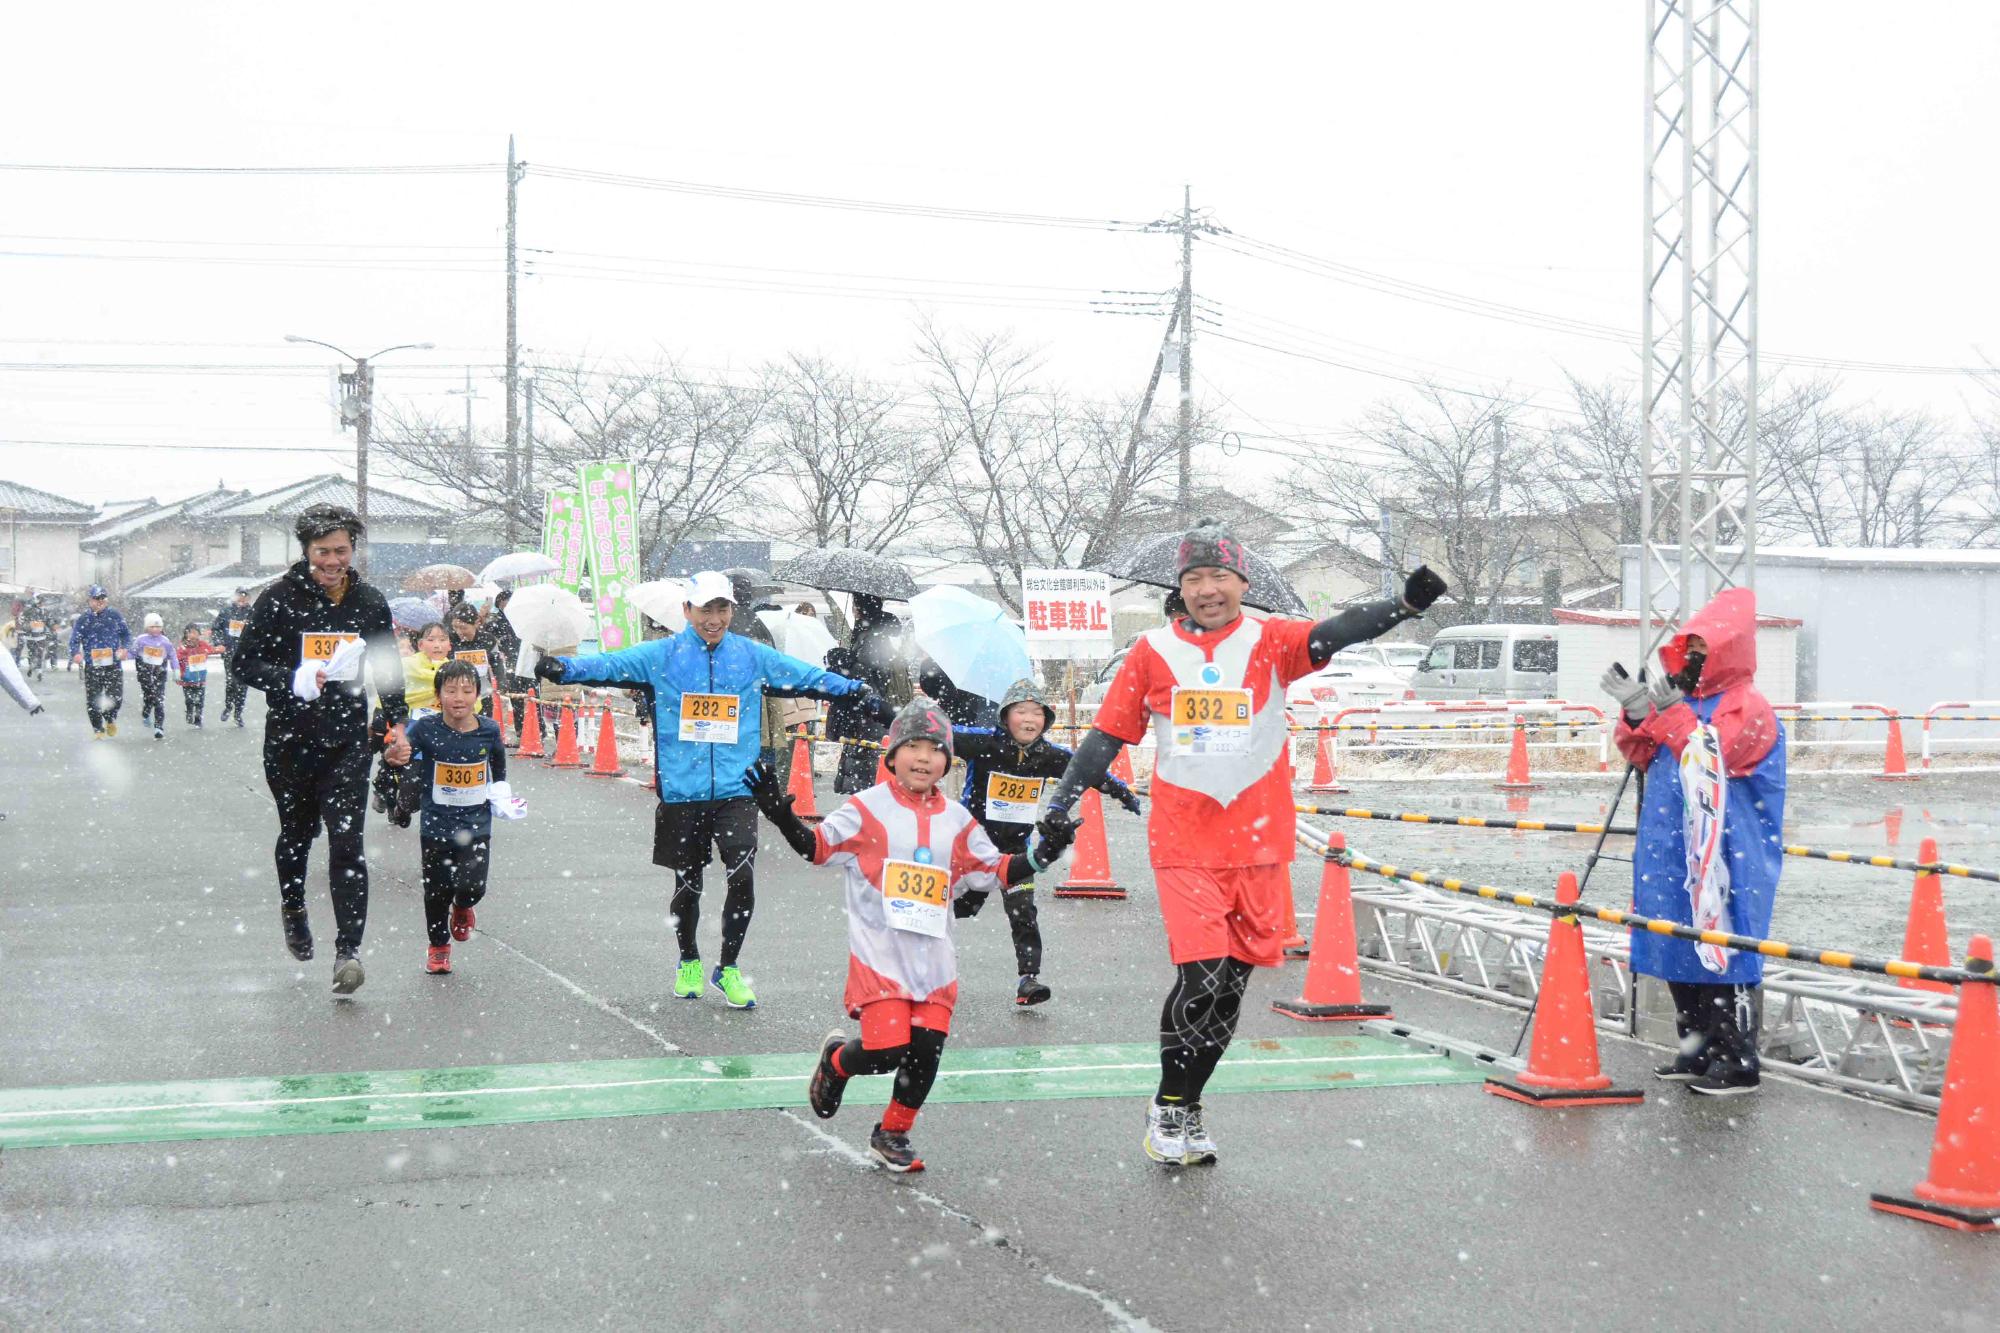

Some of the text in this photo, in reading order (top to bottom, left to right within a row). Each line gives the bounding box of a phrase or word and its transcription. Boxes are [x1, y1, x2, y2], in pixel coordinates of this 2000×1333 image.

[1028, 600, 1108, 631] 駐車禁止
[692, 700, 736, 717] 282 B
[1186, 697, 1248, 720] 332 B
[1214, 729, 1249, 738] メイコー
[445, 769, 471, 784] 330
[998, 782, 1038, 799] 282 B
[898, 871, 935, 898] 332
